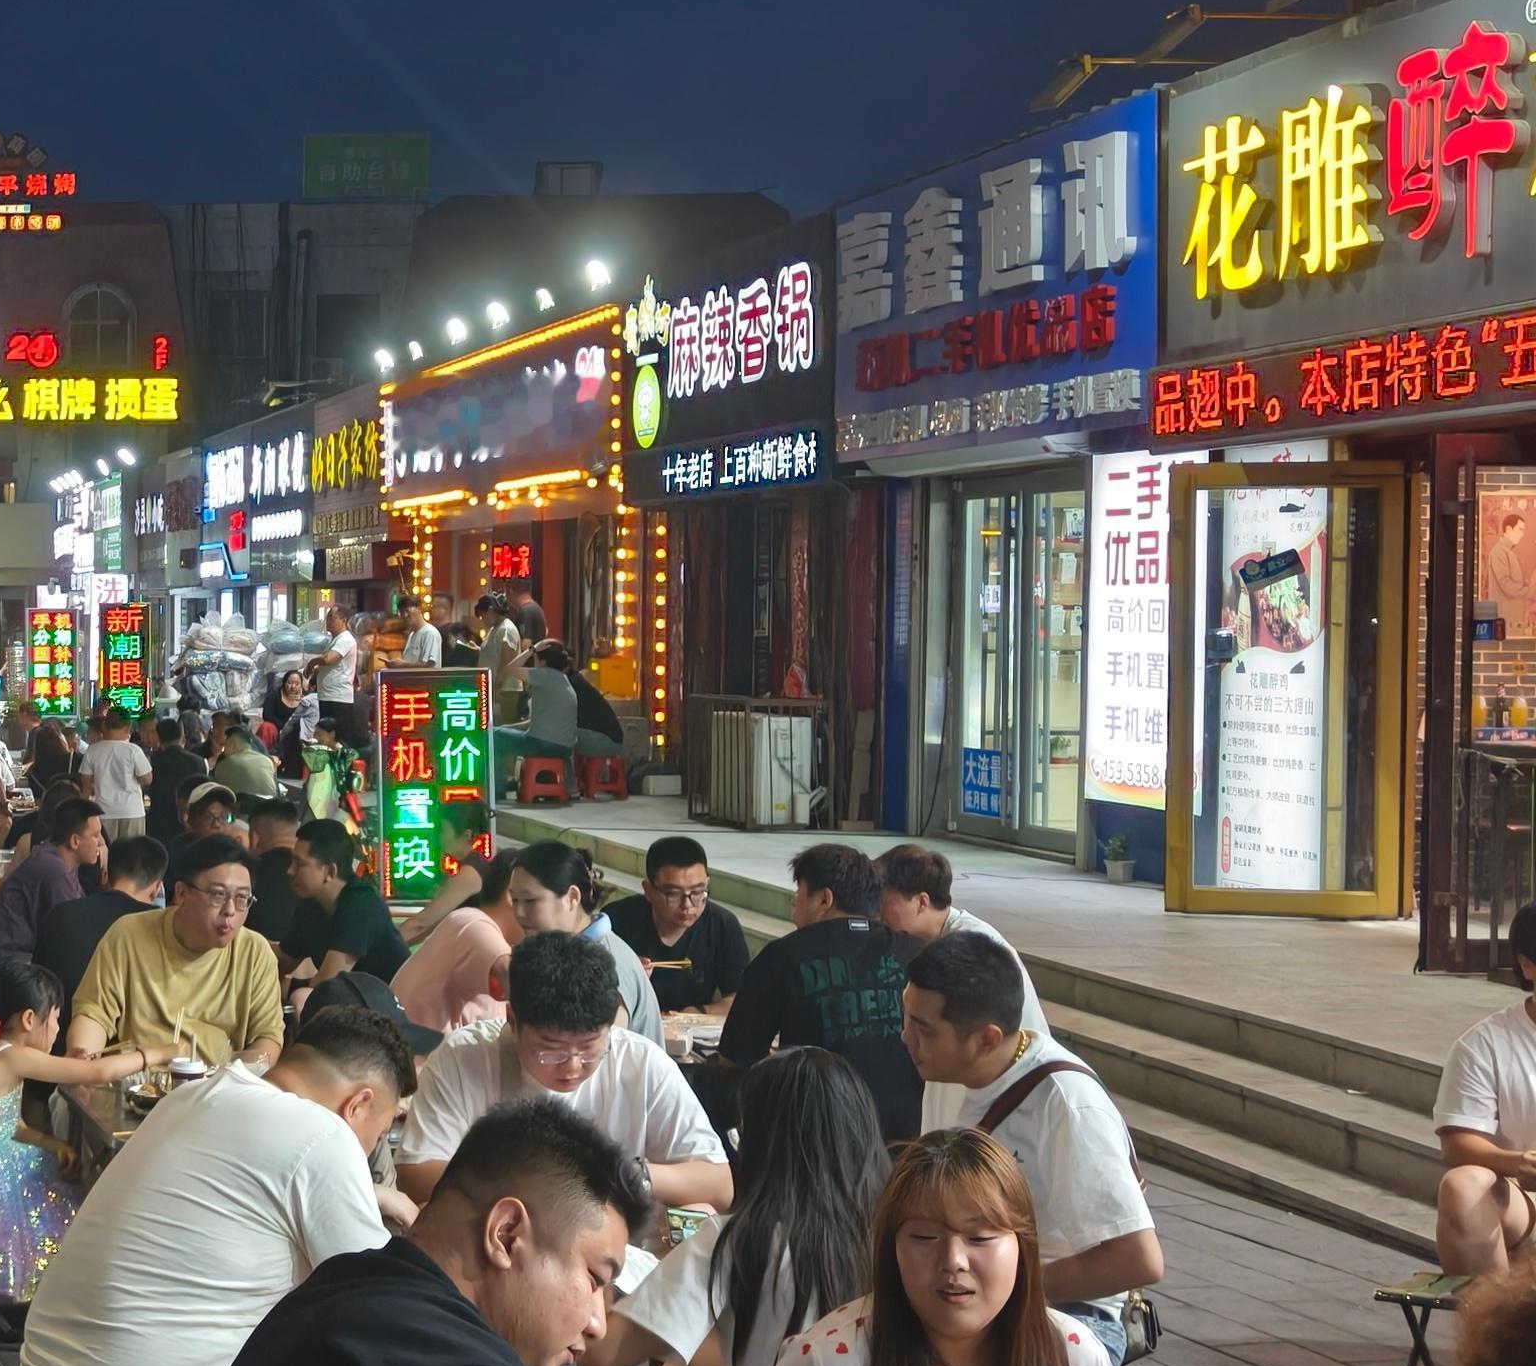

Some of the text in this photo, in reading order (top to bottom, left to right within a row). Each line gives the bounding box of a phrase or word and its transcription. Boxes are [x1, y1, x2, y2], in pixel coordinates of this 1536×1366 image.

[1183, 20, 1536, 299] 花雕醉
[667, 261, 814, 399] 麻辣香锅
[23, 378, 96, 421] 棋牌
[105, 378, 178, 421] 掼蛋
[662, 448, 714, 493] 十年老店
[1105, 461, 1171, 521] 二手
[1104, 530, 1171, 586] 优品
[32, 612, 73, 629] 手机
[105, 607, 145, 713] 新潮眼镜
[390, 691, 435, 880] 手机置换
